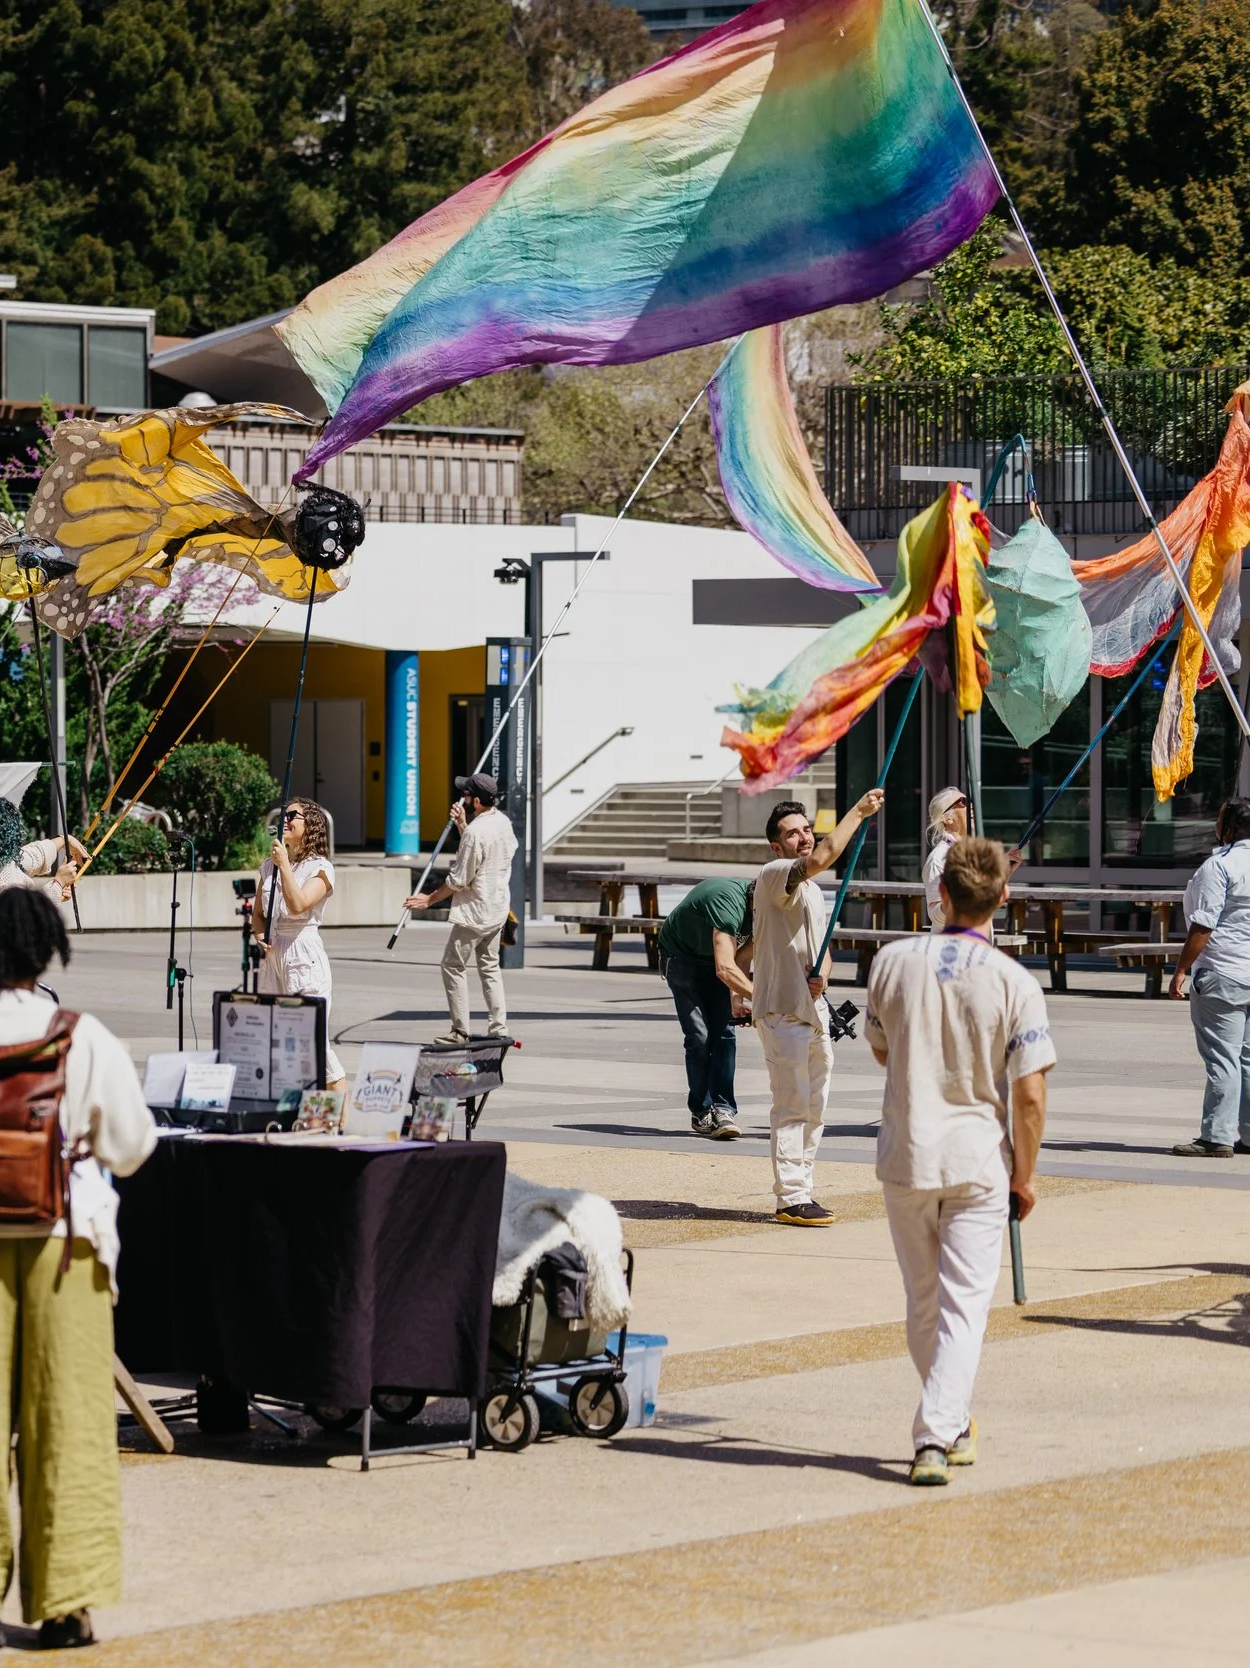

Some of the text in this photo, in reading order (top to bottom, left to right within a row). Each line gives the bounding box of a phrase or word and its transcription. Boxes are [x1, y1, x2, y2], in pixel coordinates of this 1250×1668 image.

[406, 668, 417, 816] ASUC STUDENT UNION
[516, 698, 524, 786] EMERGENCY
[363, 1084, 398, 1098] GIANT
